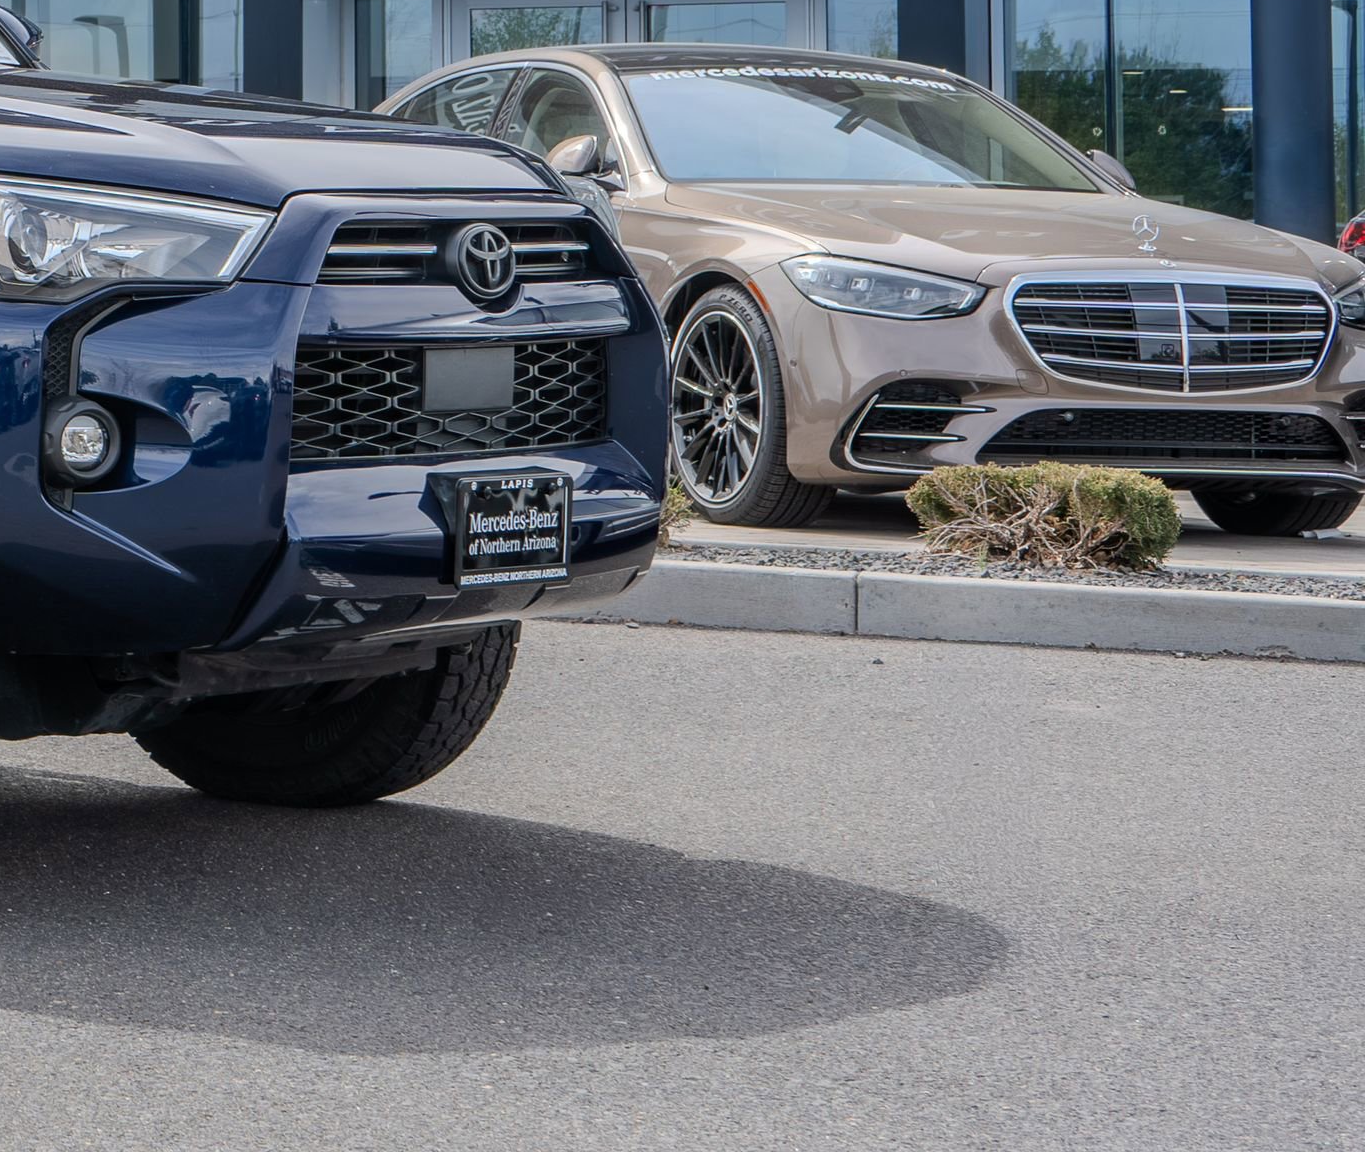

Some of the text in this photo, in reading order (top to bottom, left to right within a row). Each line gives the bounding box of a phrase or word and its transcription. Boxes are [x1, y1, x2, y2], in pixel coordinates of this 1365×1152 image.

[650, 65, 956, 92] mercedesarizona.com
[727, 297, 753, 322] ZERO
[500, 478, 534, 489] LAPIS
[469, 508, 559, 534] Mercedes-Benz
[468, 534, 557, 556] of Northern Arizona
[460, 571, 510, 586] MERCEDES-BENZ
[510, 569, 542, 582] NORTHERN
